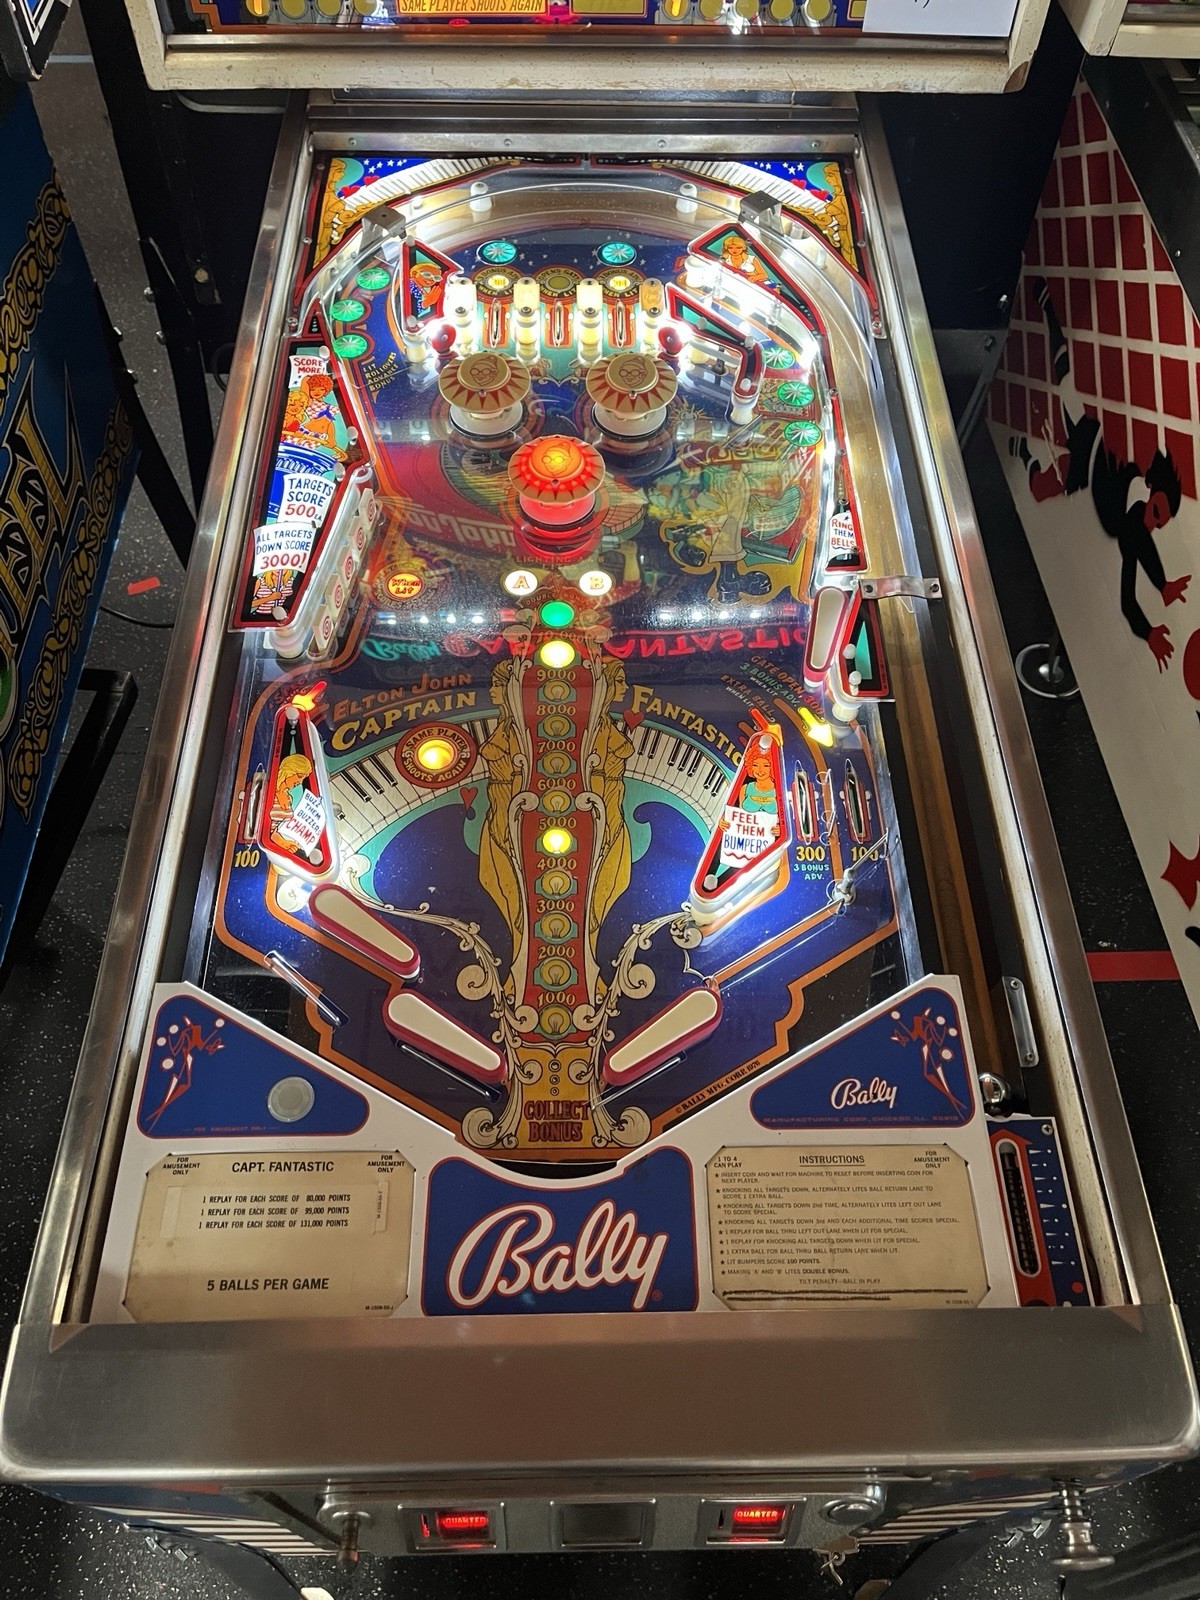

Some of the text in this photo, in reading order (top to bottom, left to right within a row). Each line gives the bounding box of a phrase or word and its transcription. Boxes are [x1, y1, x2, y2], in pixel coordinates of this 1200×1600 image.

[402, 0, 542, 11] SAME PLAYER SHOOTS AGAIN
[294, 357, 323, 366] SCORE
[288, 478, 334, 496] TARGETS
[287, 491, 326, 508] SCORE
[285, 504, 316, 518] 500
[832, 518, 854, 530] RING
[256, 530, 313, 544] ALL TARGETS
[834, 528, 855, 538] THEM
[256, 540, 311, 556] DOWN SCORE
[831, 537, 856, 548] BELLS
[260, 552, 308, 570] 3000!
[512, 575, 530, 589] A
[590, 576, 605, 590] B
[536, 670, 576, 681] 9000
[740, 662, 801, 707] 3 BONUS ADV.
[750, 676, 778, 696] WHEN LIT
[751, 655, 780, 674] GATE
[804, 695, 825, 715] 300
[720, 674, 776, 716] EXTRA BALL
[725, 686, 754, 708] WHEN LIT
[332, 686, 404, 722] ELTON
[536, 704, 576, 716] 8000
[331, 691, 476, 751] CAPTAIN
[406, 727, 470, 750] SAME PLAYER
[537, 740, 576, 753] 7000
[403, 758, 467, 782] SHOOTS AGAIN
[537, 778, 576, 790] 6000
[304, 792, 322, 808] BUZZ
[304, 802, 322, 820] THEM
[732, 810, 759, 825] FEEL
[538, 817, 577, 830] 5000
[736, 823, 765, 837] THEM
[285, 818, 316, 845] CHAMP
[724, 834, 770, 854] BUMPERS
[234, 849, 260, 868] 100
[796, 846, 826, 862] 300
[536, 857, 577, 871] 4000
[794, 864, 830, 872] 3 BONUS
[536, 900, 575, 913] 3000
[538, 946, 576, 959] 2000
[537, 992, 576, 1006] 1000
[831, 1077, 898, 1110] Bally
[524, 1100, 590, 1120] COLLECT
[528, 1121, 583, 1142] BONUS
[232, 1161, 334, 1173] CAPT. FANTASTIC
[799, 1156, 865, 1164] INSTRUCTIONS
[210, 1195, 232, 1203] REPLAY
[234, 1195, 247, 1203] FOR
[306, 1194, 326, 1202] 80,000
[328, 1194, 350, 1202] POINTS
[208, 1208, 231, 1216] REPLAY
[234, 1208, 246, 1216] FOR
[249, 1207, 265, 1215] EACH
[268, 1207, 288, 1215] SCORE
[290, 1207, 298, 1215] OF
[304, 1207, 325, 1215] 99,000
[328, 1207, 350, 1215] POINTS
[206, 1221, 229, 1229] REPLAY
[231, 1221, 244, 1229] FOR
[246, 1220, 263, 1228] EACH
[266, 1220, 286, 1228] SCORE
[288, 1220, 296, 1228] OF
[300, 1220, 323, 1228] 131,000
[326, 1220, 348, 1228] POINTS
[446, 1198, 669, 1310] Bally
[207, 1278, 330, 1292] 5 BALLS PER GAME
[736, 1510, 779, 1518] QUARTER
